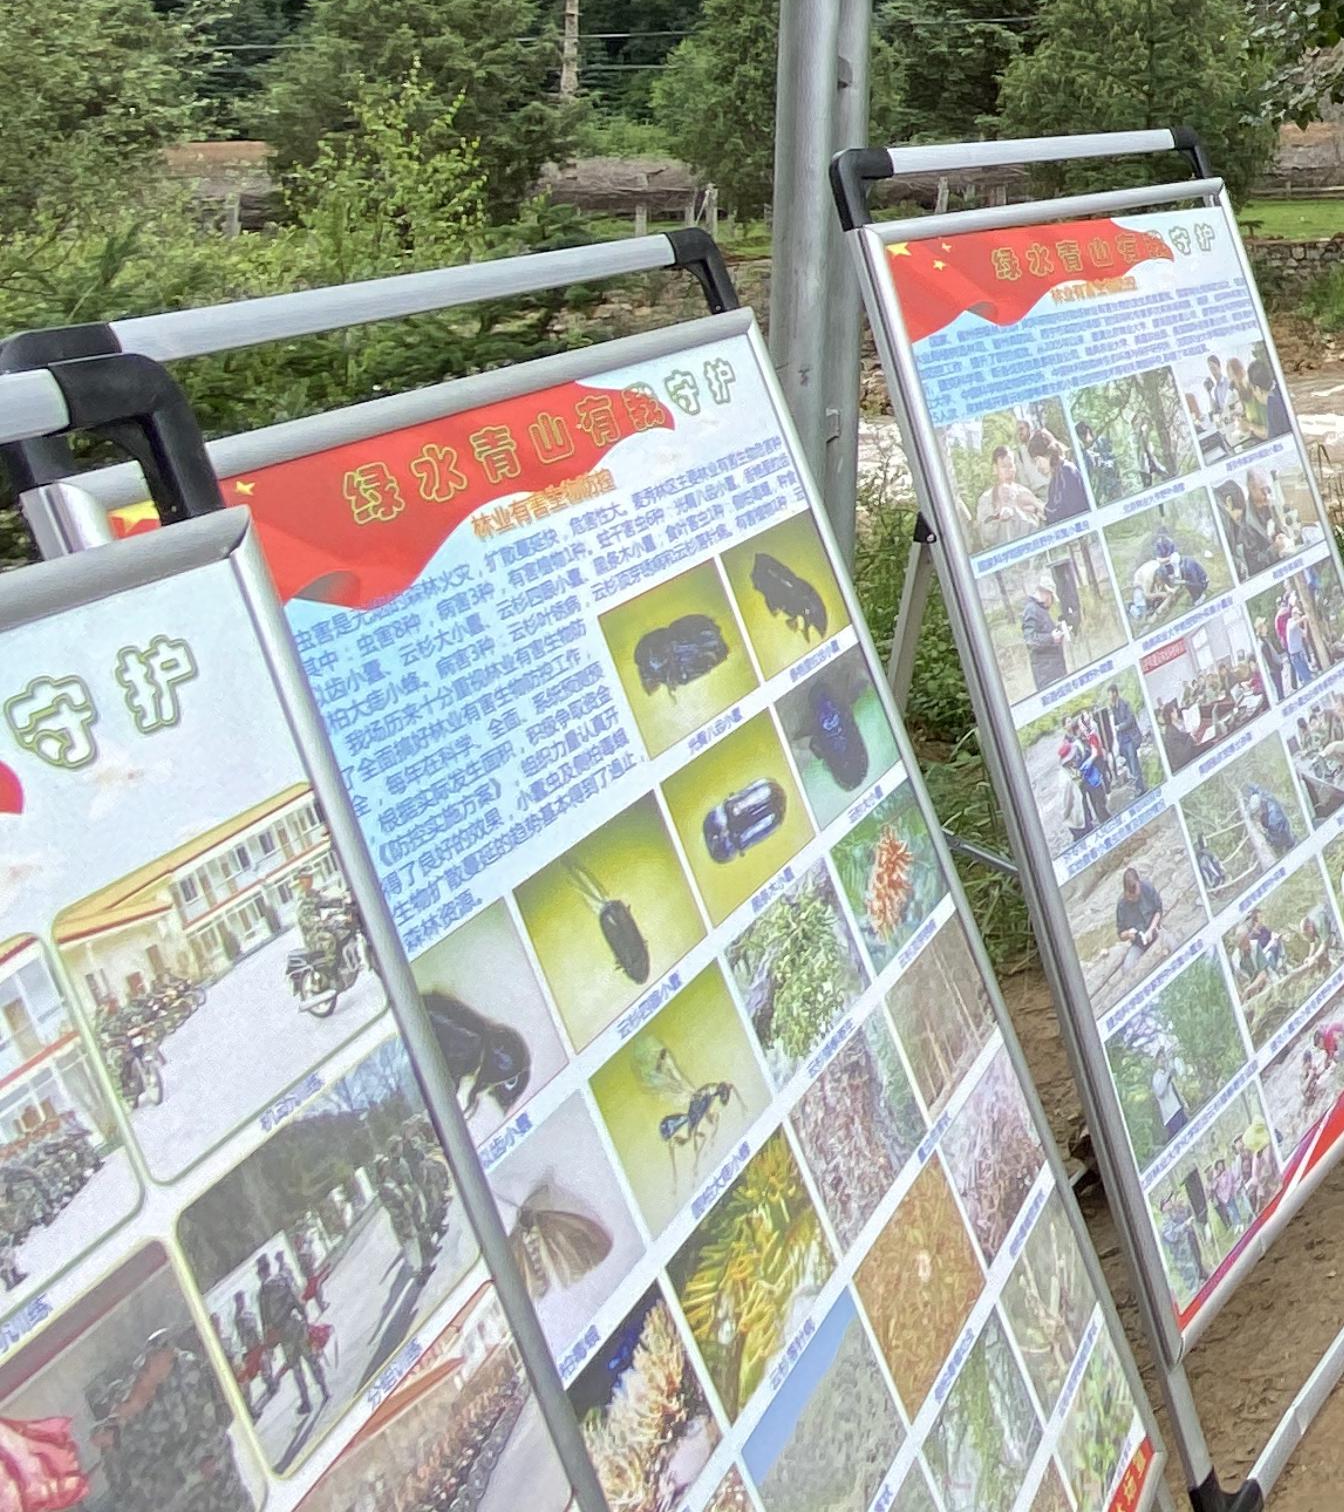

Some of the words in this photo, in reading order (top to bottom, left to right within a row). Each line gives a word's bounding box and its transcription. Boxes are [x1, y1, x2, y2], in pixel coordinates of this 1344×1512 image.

[342, 357, 737, 525] 绿水青山有我守护
[4, 634, 198, 769] 守护
